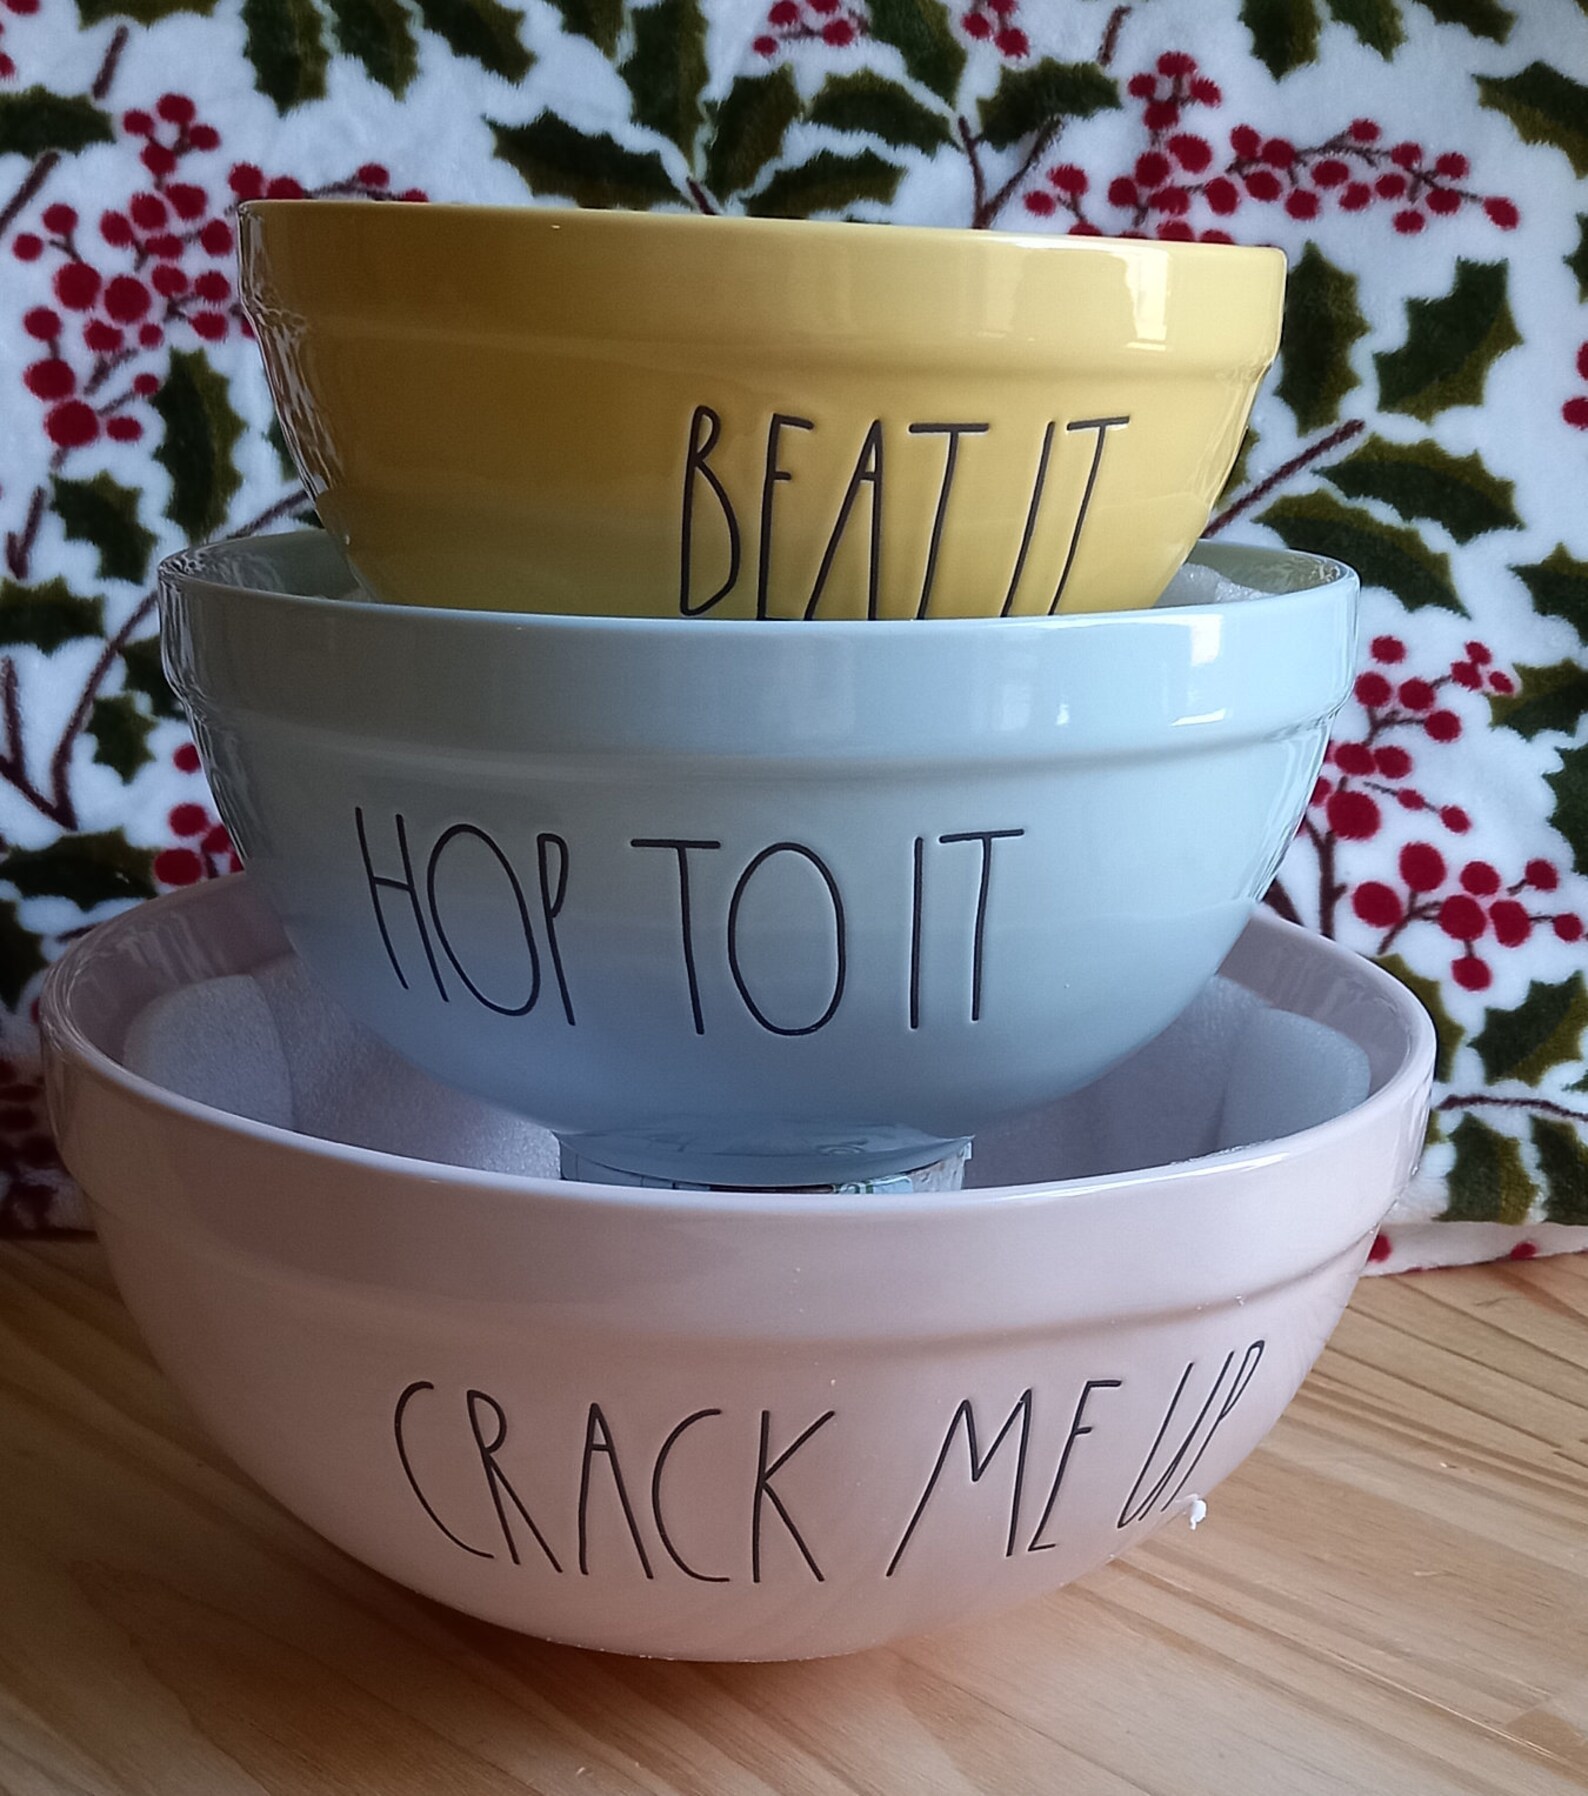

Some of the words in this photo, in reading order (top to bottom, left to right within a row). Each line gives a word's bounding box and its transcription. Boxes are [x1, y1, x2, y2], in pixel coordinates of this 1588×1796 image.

[680, 405, 990, 621] BEAT
[1000, 415, 1130, 618] IT
[355, 806, 575, 1026] HOP
[631, 838, 846, 1036] TO
[909, 828, 1025, 1030] IT
[394, 1381, 835, 1583] CRACK
[886, 1379, 1123, 1578] ME
[1117, 1340, 1267, 1530] UP
